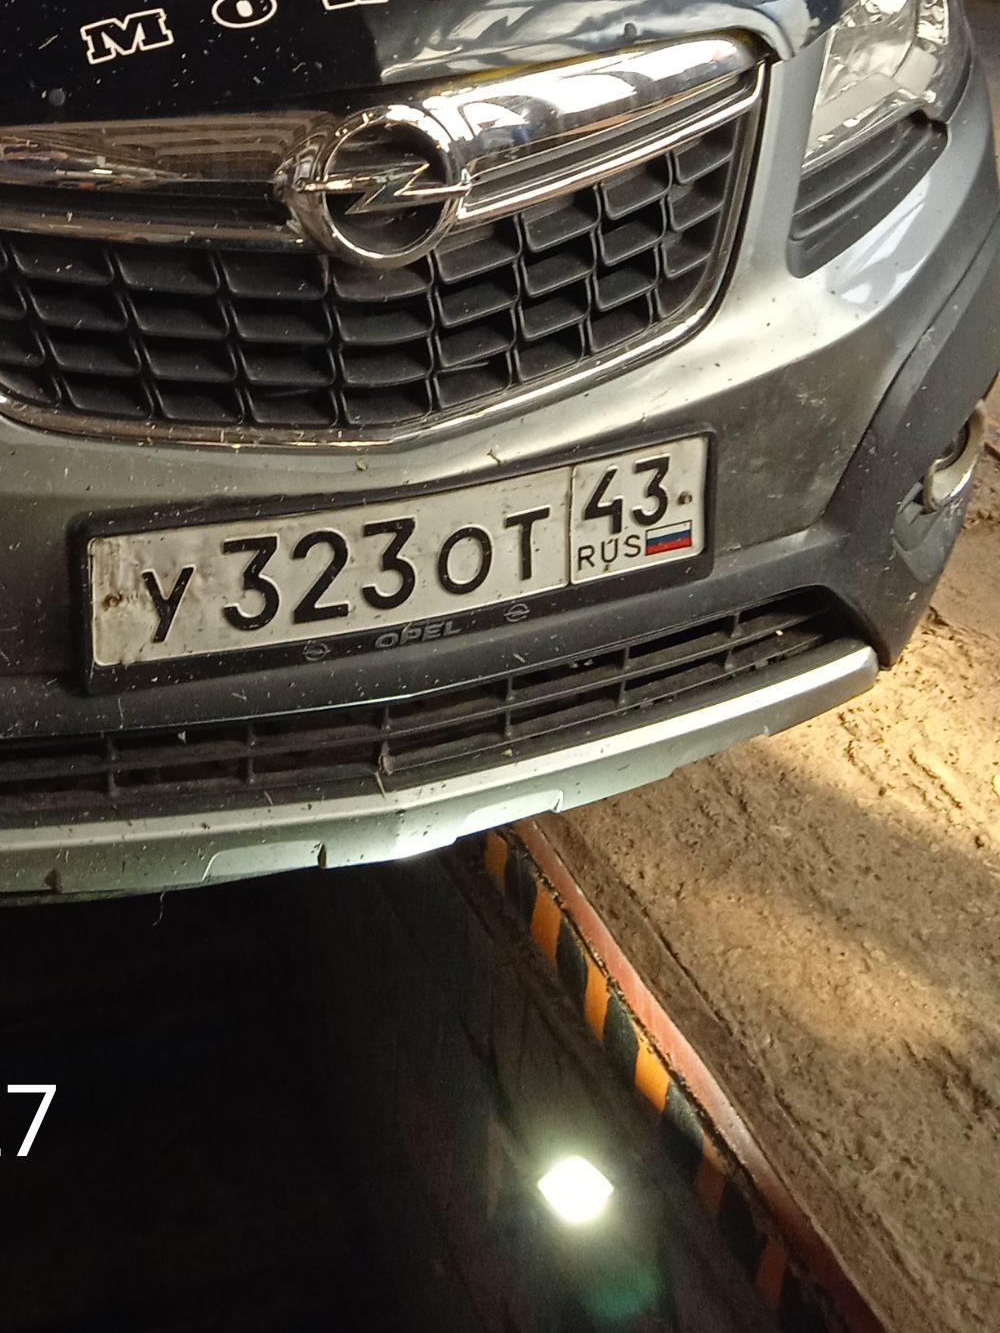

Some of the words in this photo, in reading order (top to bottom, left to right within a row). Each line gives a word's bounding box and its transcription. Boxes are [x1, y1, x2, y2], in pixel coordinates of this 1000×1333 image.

[583, 455, 671, 535] 43
[576, 535, 643, 572] RUS
[374, 620, 462, 650] OPEL
